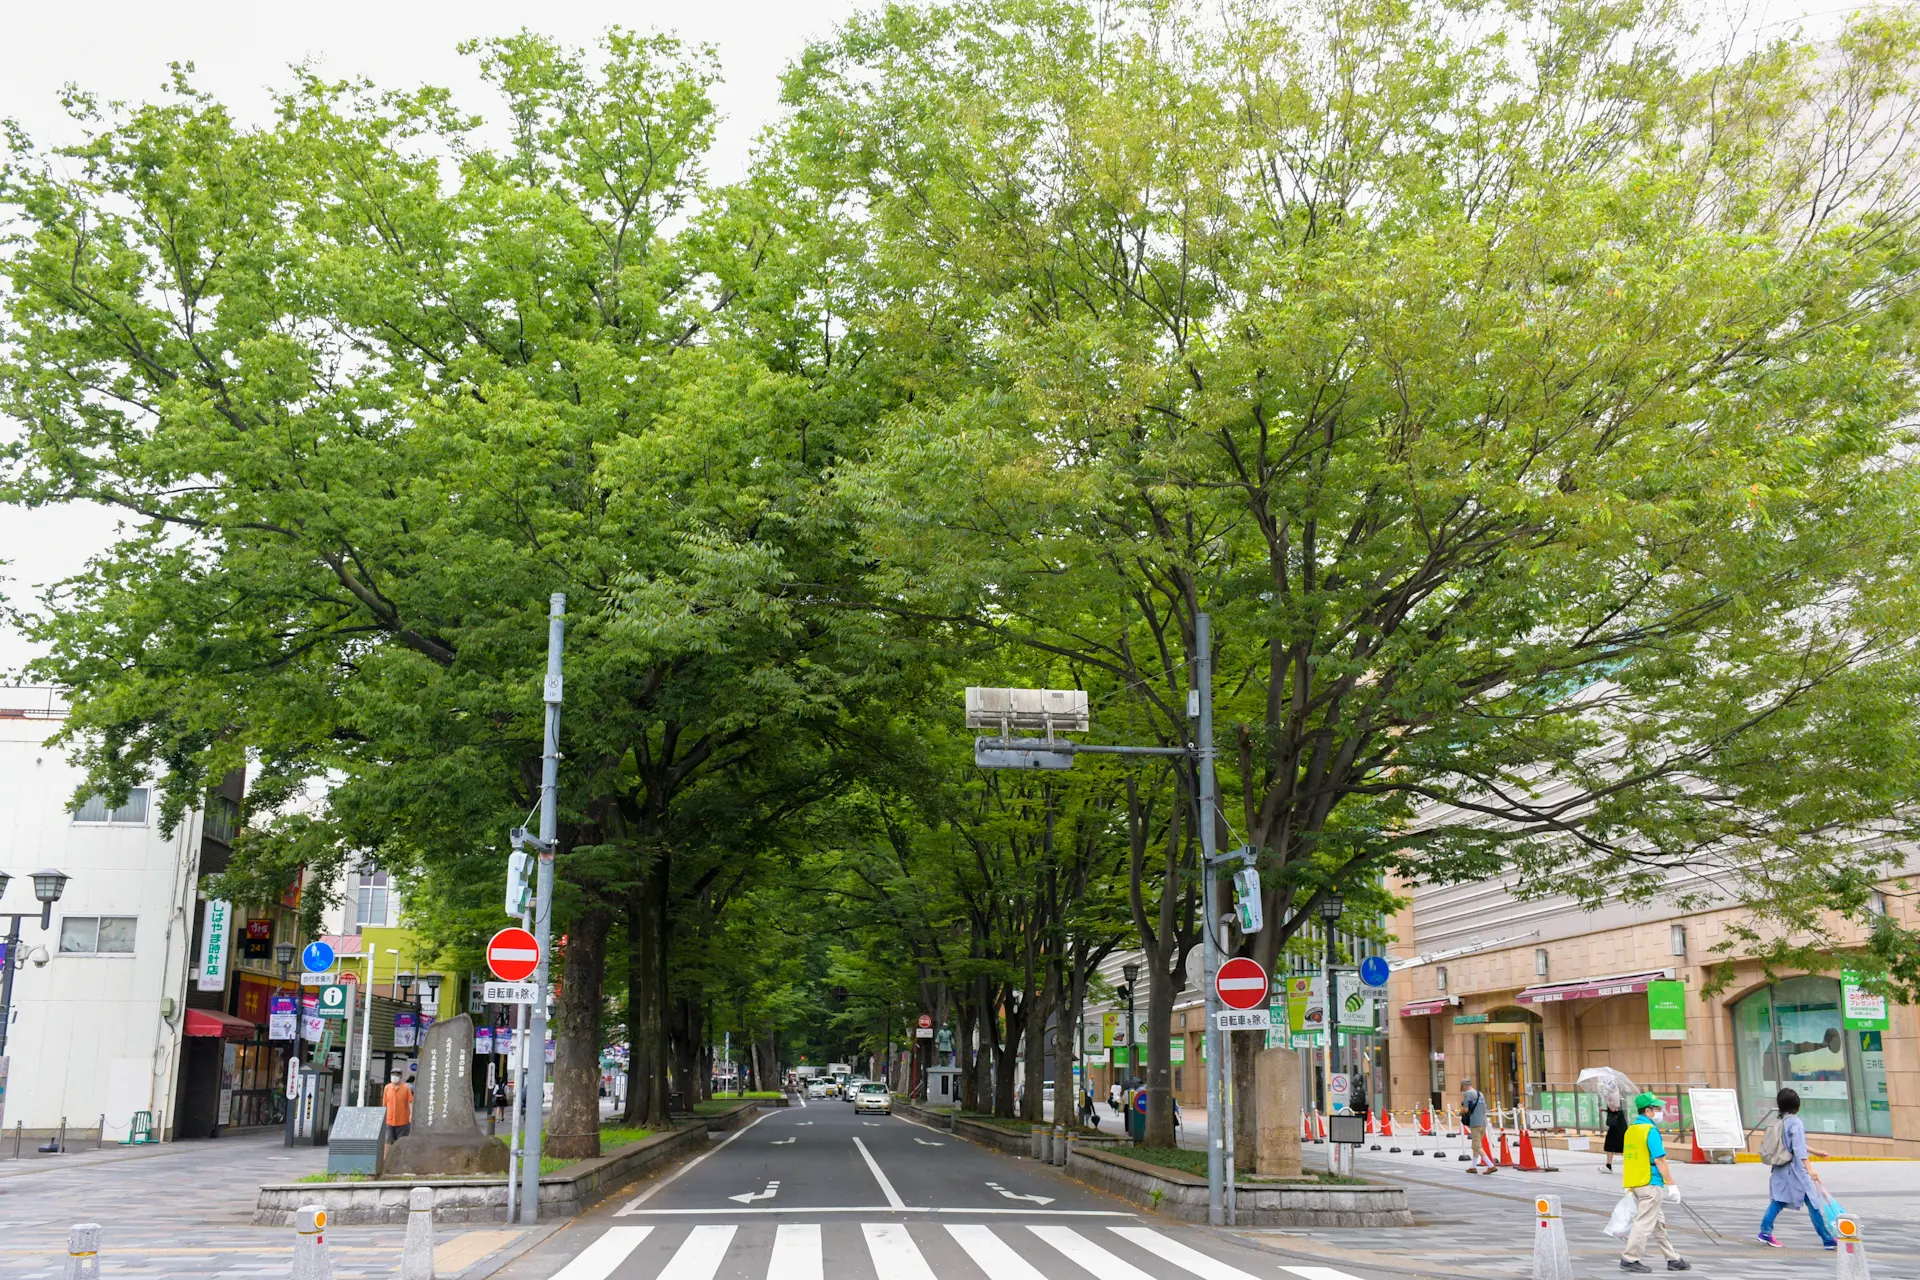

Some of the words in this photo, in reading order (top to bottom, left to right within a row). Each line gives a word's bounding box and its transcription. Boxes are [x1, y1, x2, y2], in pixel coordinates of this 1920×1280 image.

[206, 902, 224, 975] しばやま時計店
[488, 988, 535, 999] 自転車を除く
[1221, 1014, 1267, 1026] 自転車を除く
[1532, 1114, 1551, 1124] 入口
